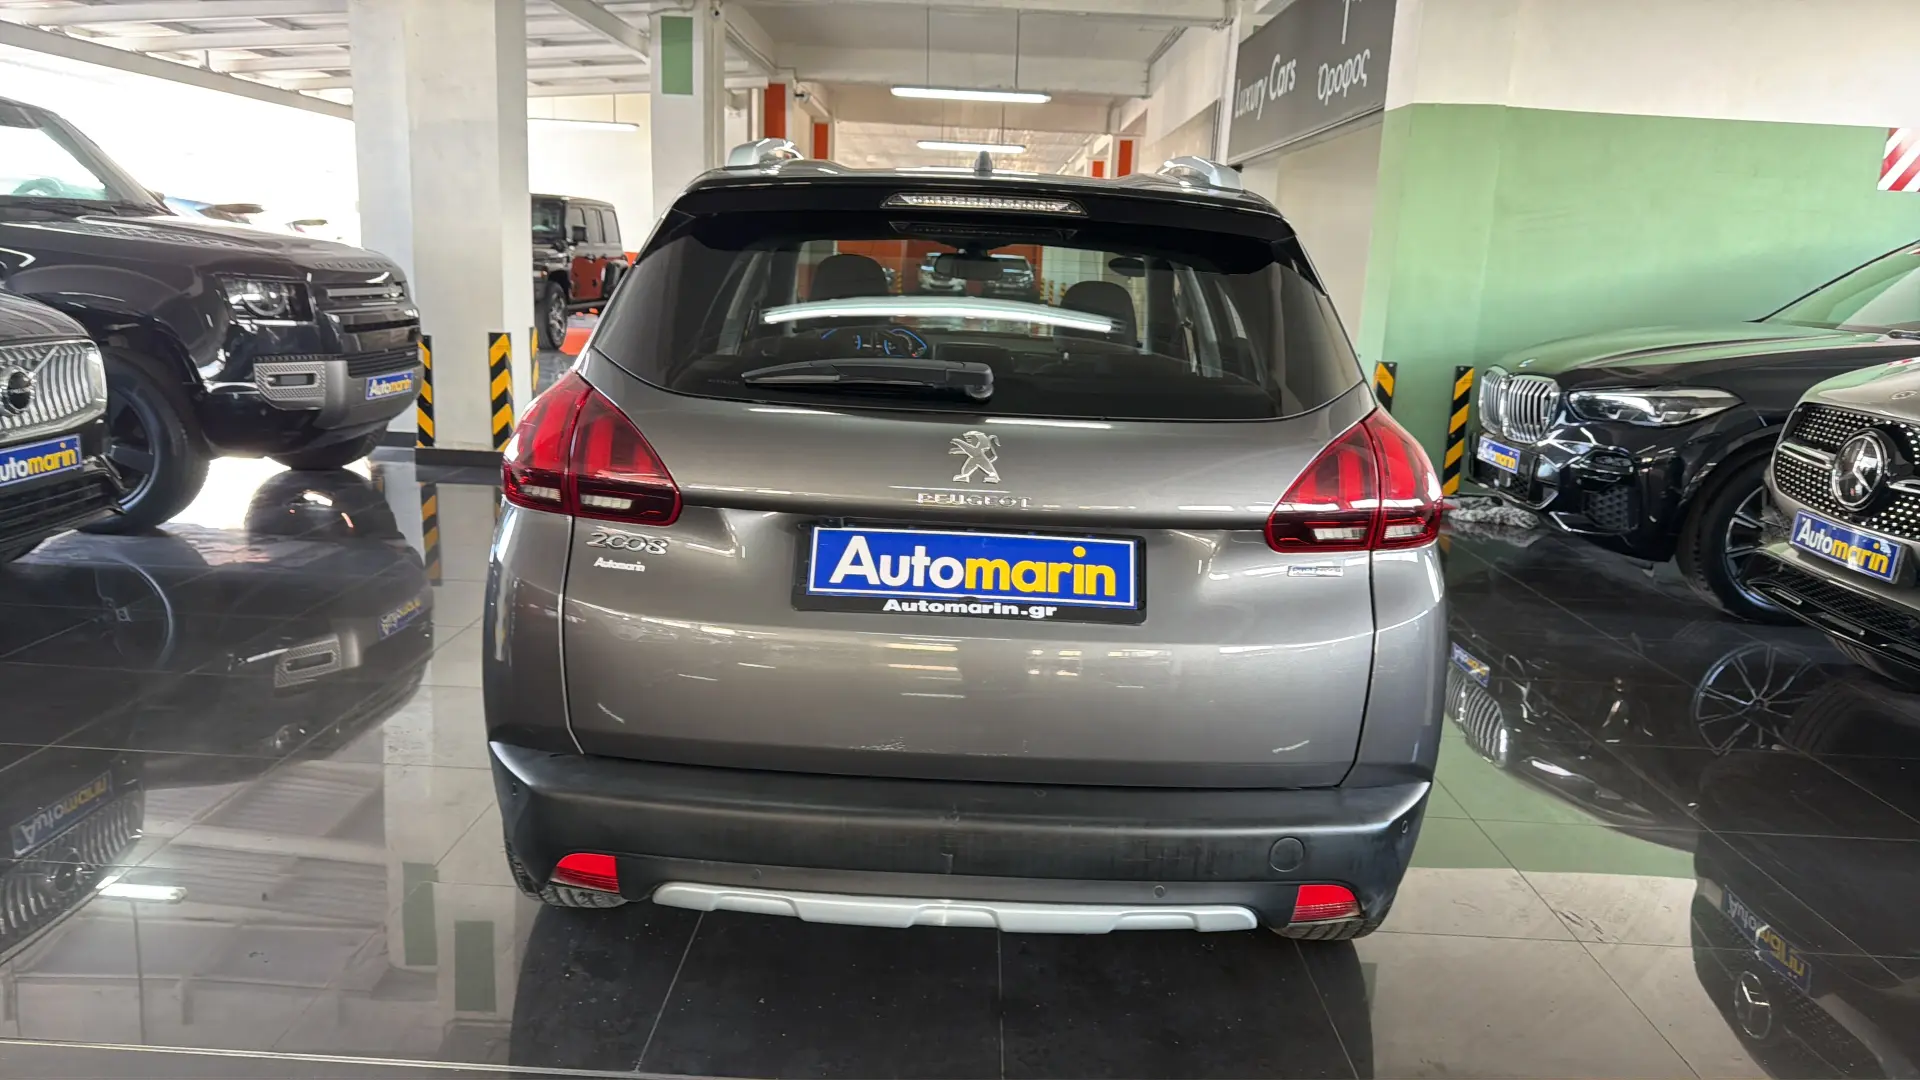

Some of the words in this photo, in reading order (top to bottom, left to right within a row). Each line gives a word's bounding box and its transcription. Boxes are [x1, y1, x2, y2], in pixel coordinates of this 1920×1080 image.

[1269, 54, 1297, 100] Cars
[0, 442, 77, 482] utomarin
[917, 493, 1031, 508] PEUGEOT
[586, 532, 669, 555] 2008
[1796, 517, 1889, 573] Automarin
[829, 535, 1116, 597] Automarin
[882, 598, 1058, 619] Automarin.gr
